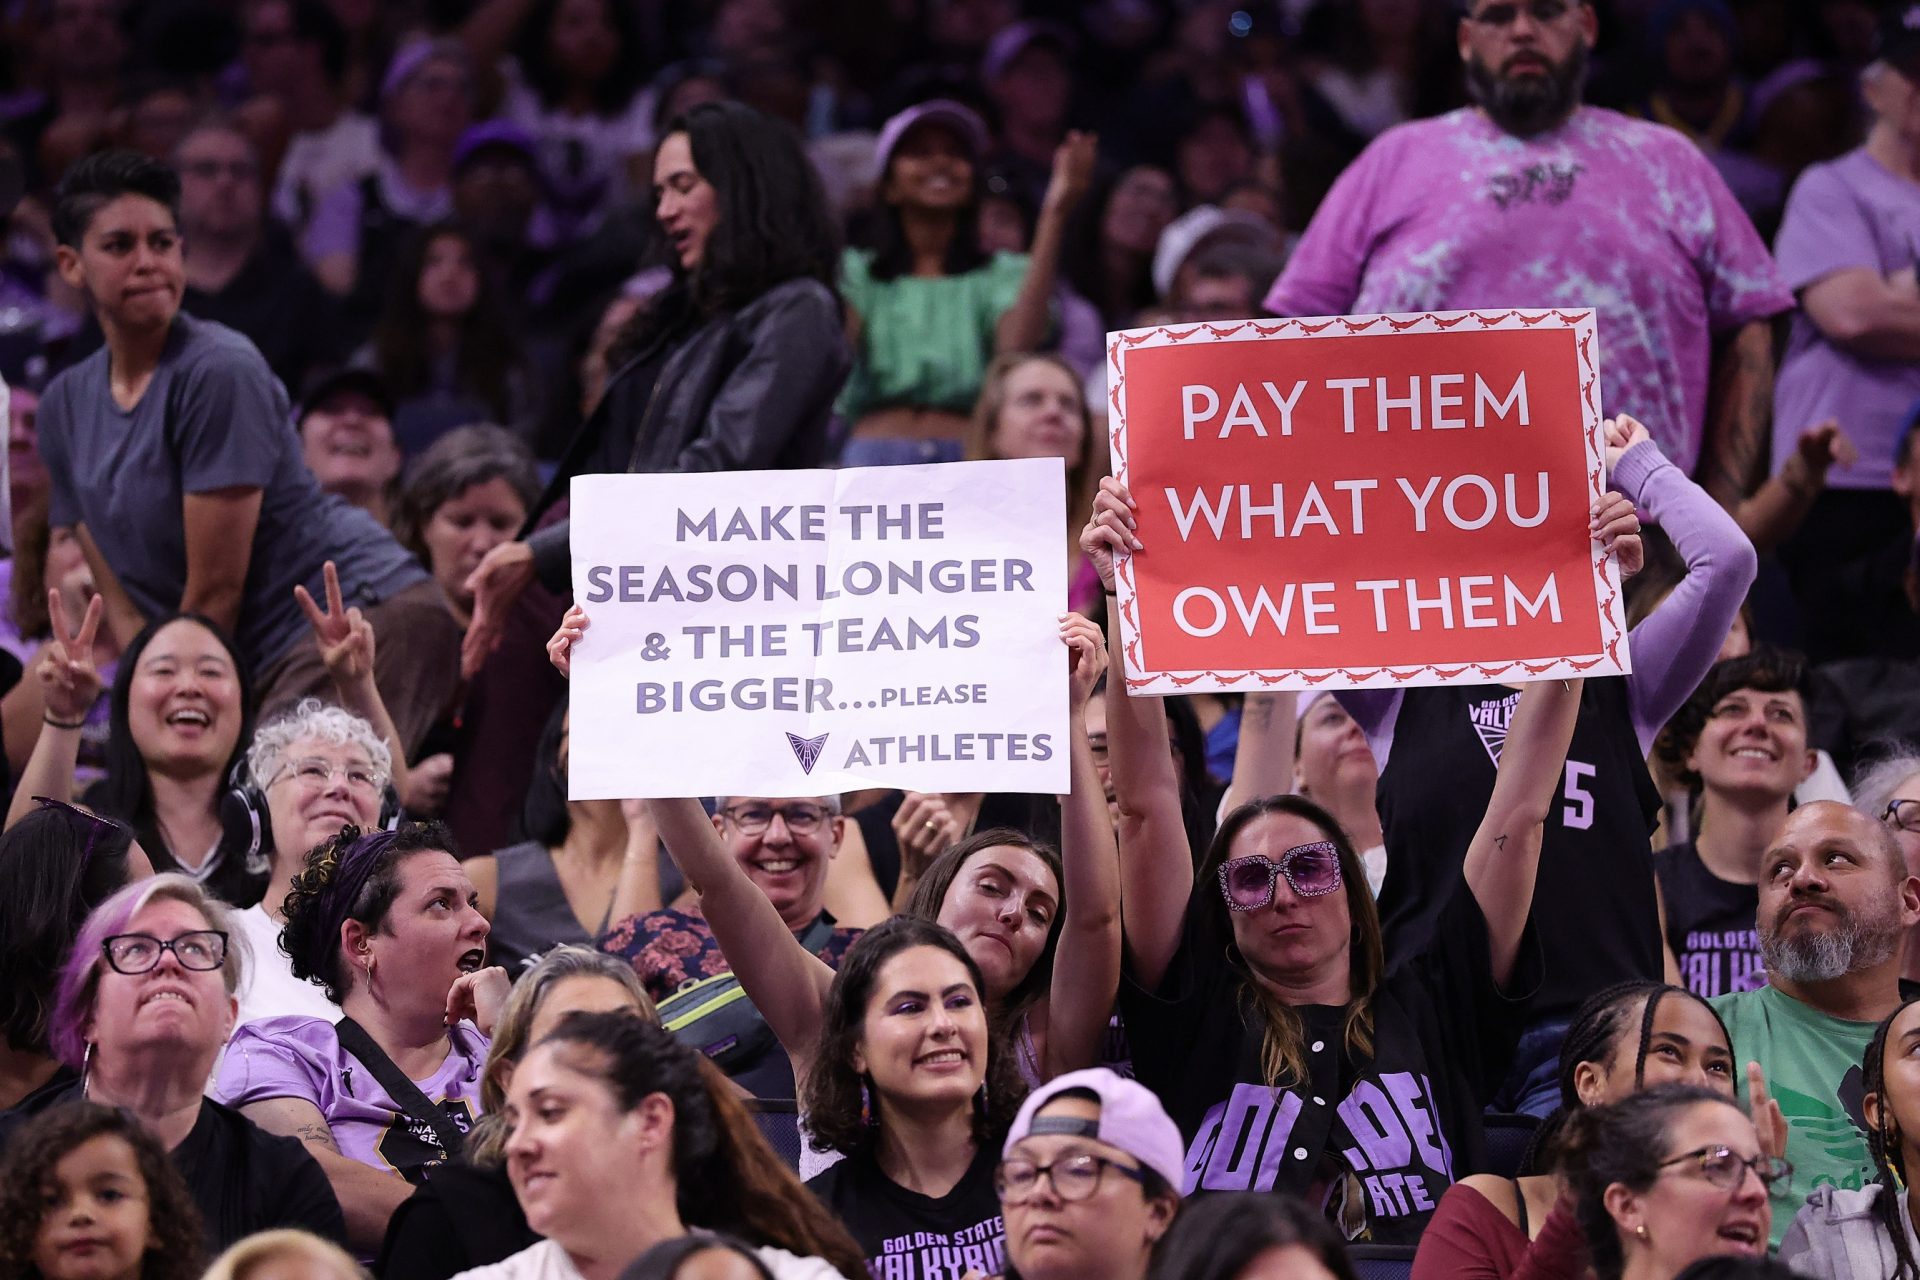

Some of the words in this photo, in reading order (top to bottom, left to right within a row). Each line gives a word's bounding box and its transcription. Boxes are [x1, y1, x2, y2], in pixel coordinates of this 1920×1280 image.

[1182, 380, 1308, 440] PAY
[1325, 370, 1530, 433] THEM
[675, 504, 826, 542] MAKE
[839, 502, 945, 541] THE
[1164, 479, 1378, 542] WHAT
[1395, 471, 1550, 532] YOU
[586, 563, 799, 604] SEASON
[815, 558, 1036, 600] LONGER
[1172, 582, 1340, 638] OWE
[1355, 572, 1563, 632] THEM
[640, 631, 672, 662] &
[681, 624, 787, 660] THE
[801, 614, 981, 658] TEAMS
[1468, 703, 1517, 730] VALK
[843, 732, 1053, 769] ATHLETES
[1563, 759, 1597, 831] 5
[1686, 929, 1761, 951] GOLDEN
[1364, 1172, 1436, 1217] ATE
[883, 1231, 949, 1254] GOLDEN
[953, 1215, 1004, 1246] STATE
